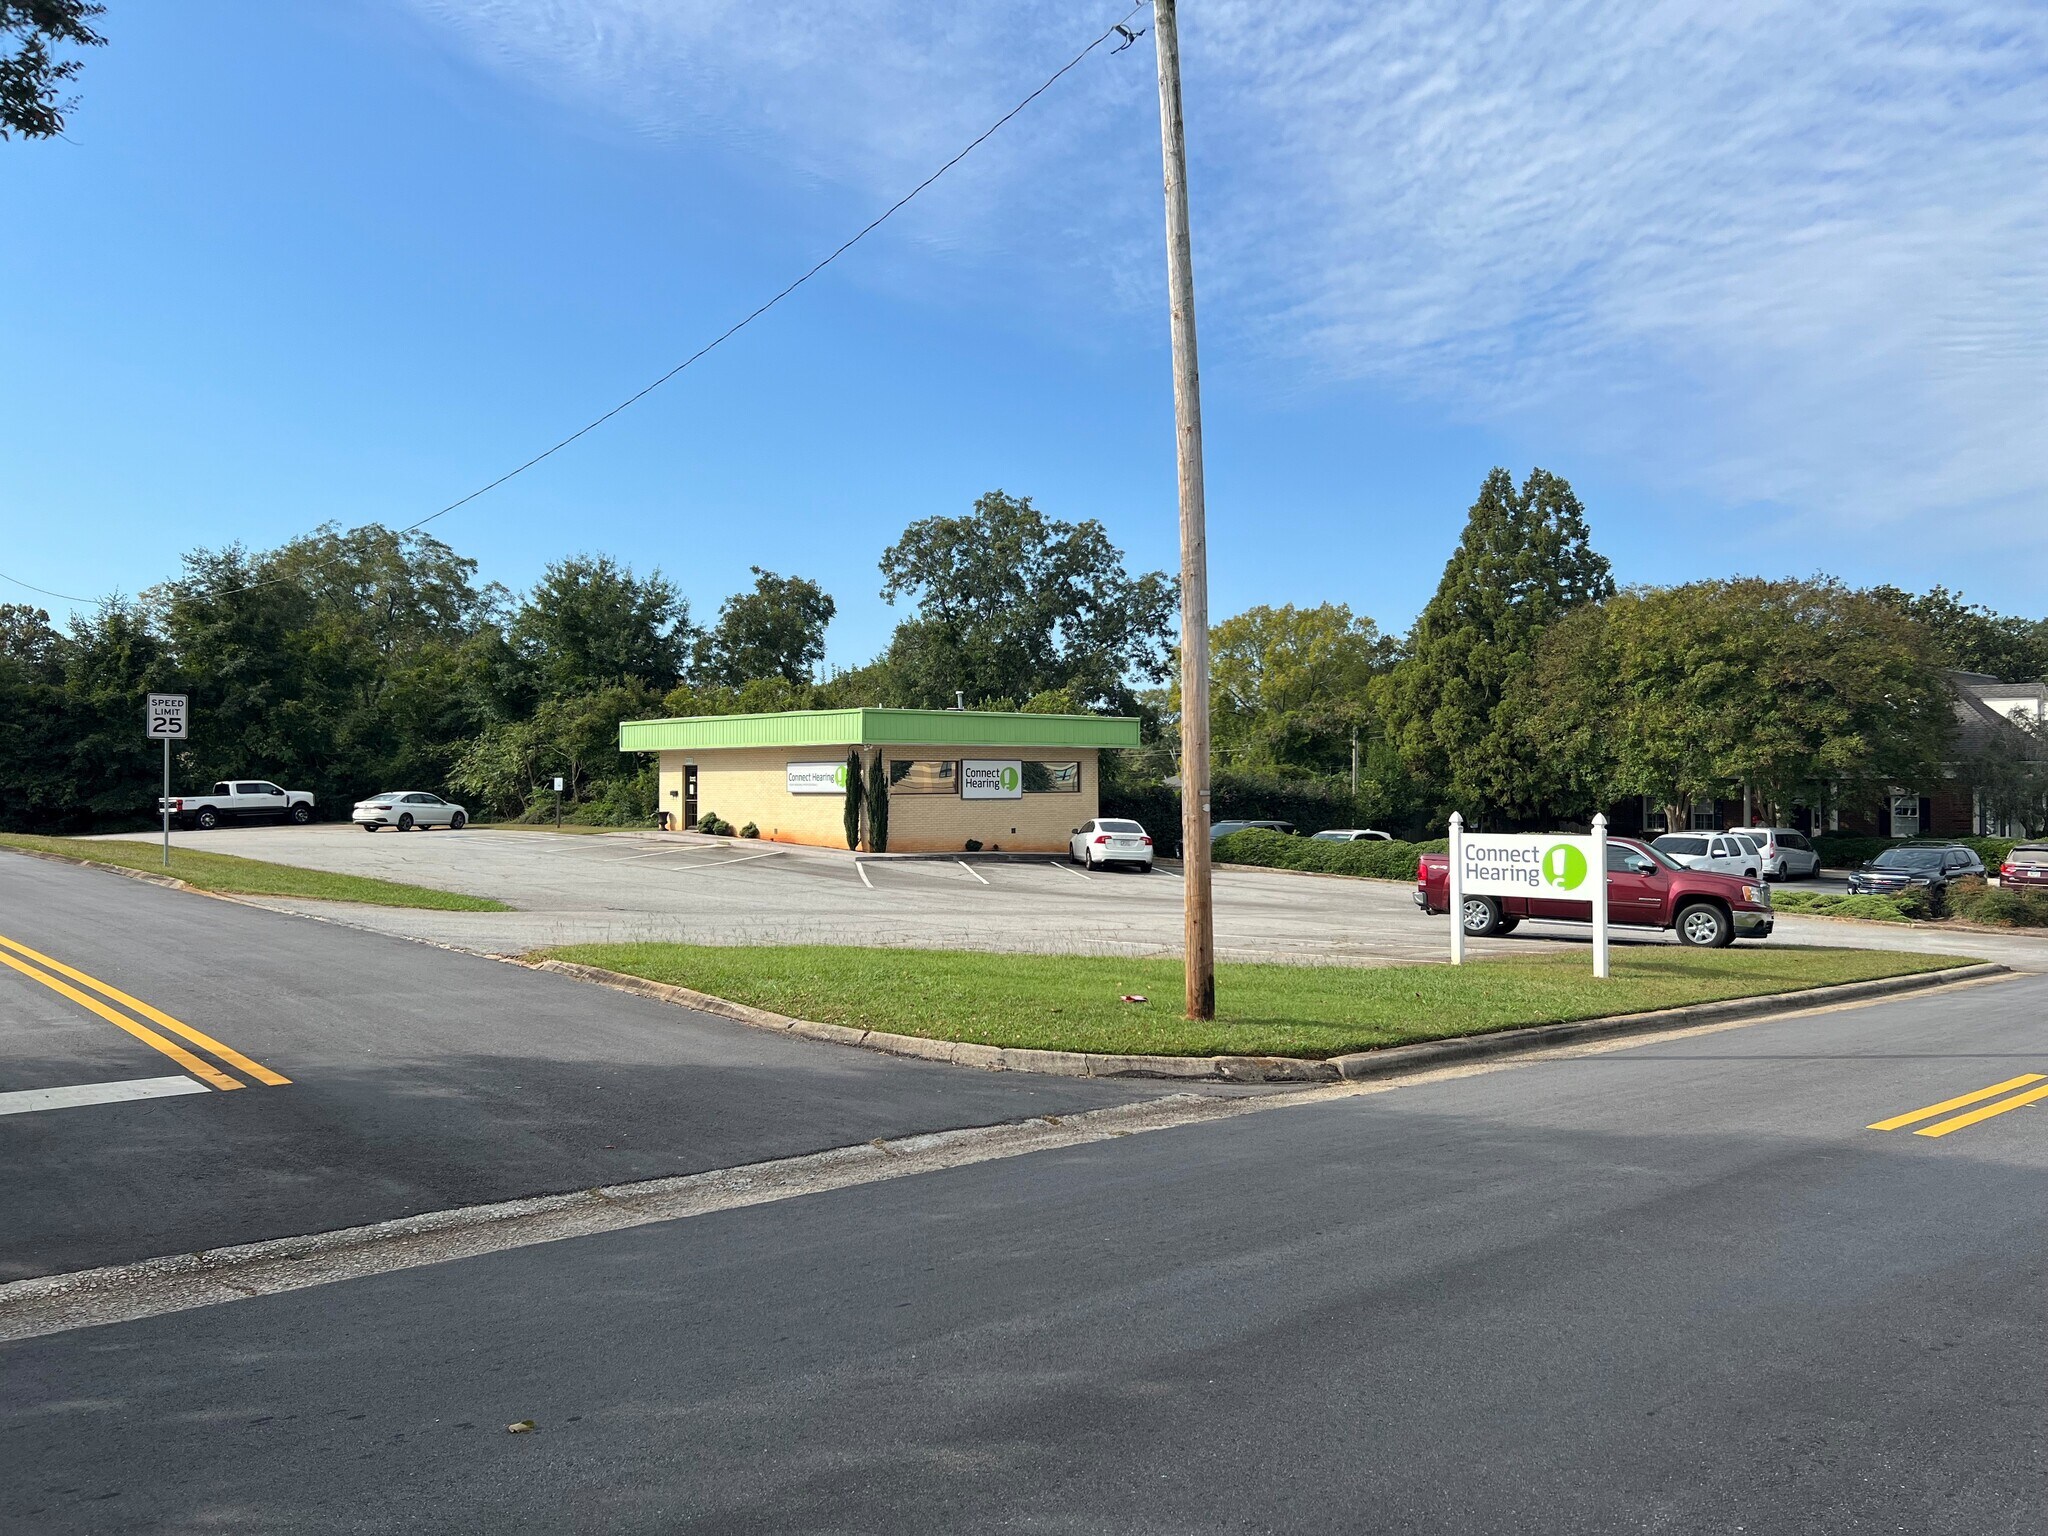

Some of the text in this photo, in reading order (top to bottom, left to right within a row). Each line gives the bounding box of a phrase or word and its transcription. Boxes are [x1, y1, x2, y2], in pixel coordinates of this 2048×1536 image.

[151, 698, 184, 707] SPEED
[154, 708, 181, 716] LIMIT
[152, 716, 183, 733] 25
[788, 772, 835, 784] Connect Hearing
[965, 767, 1000, 778] Connect
[965, 778, 1000, 791] Hearing
[1465, 843, 1540, 864] Connect
[1466, 862, 1540, 887] Hearing
